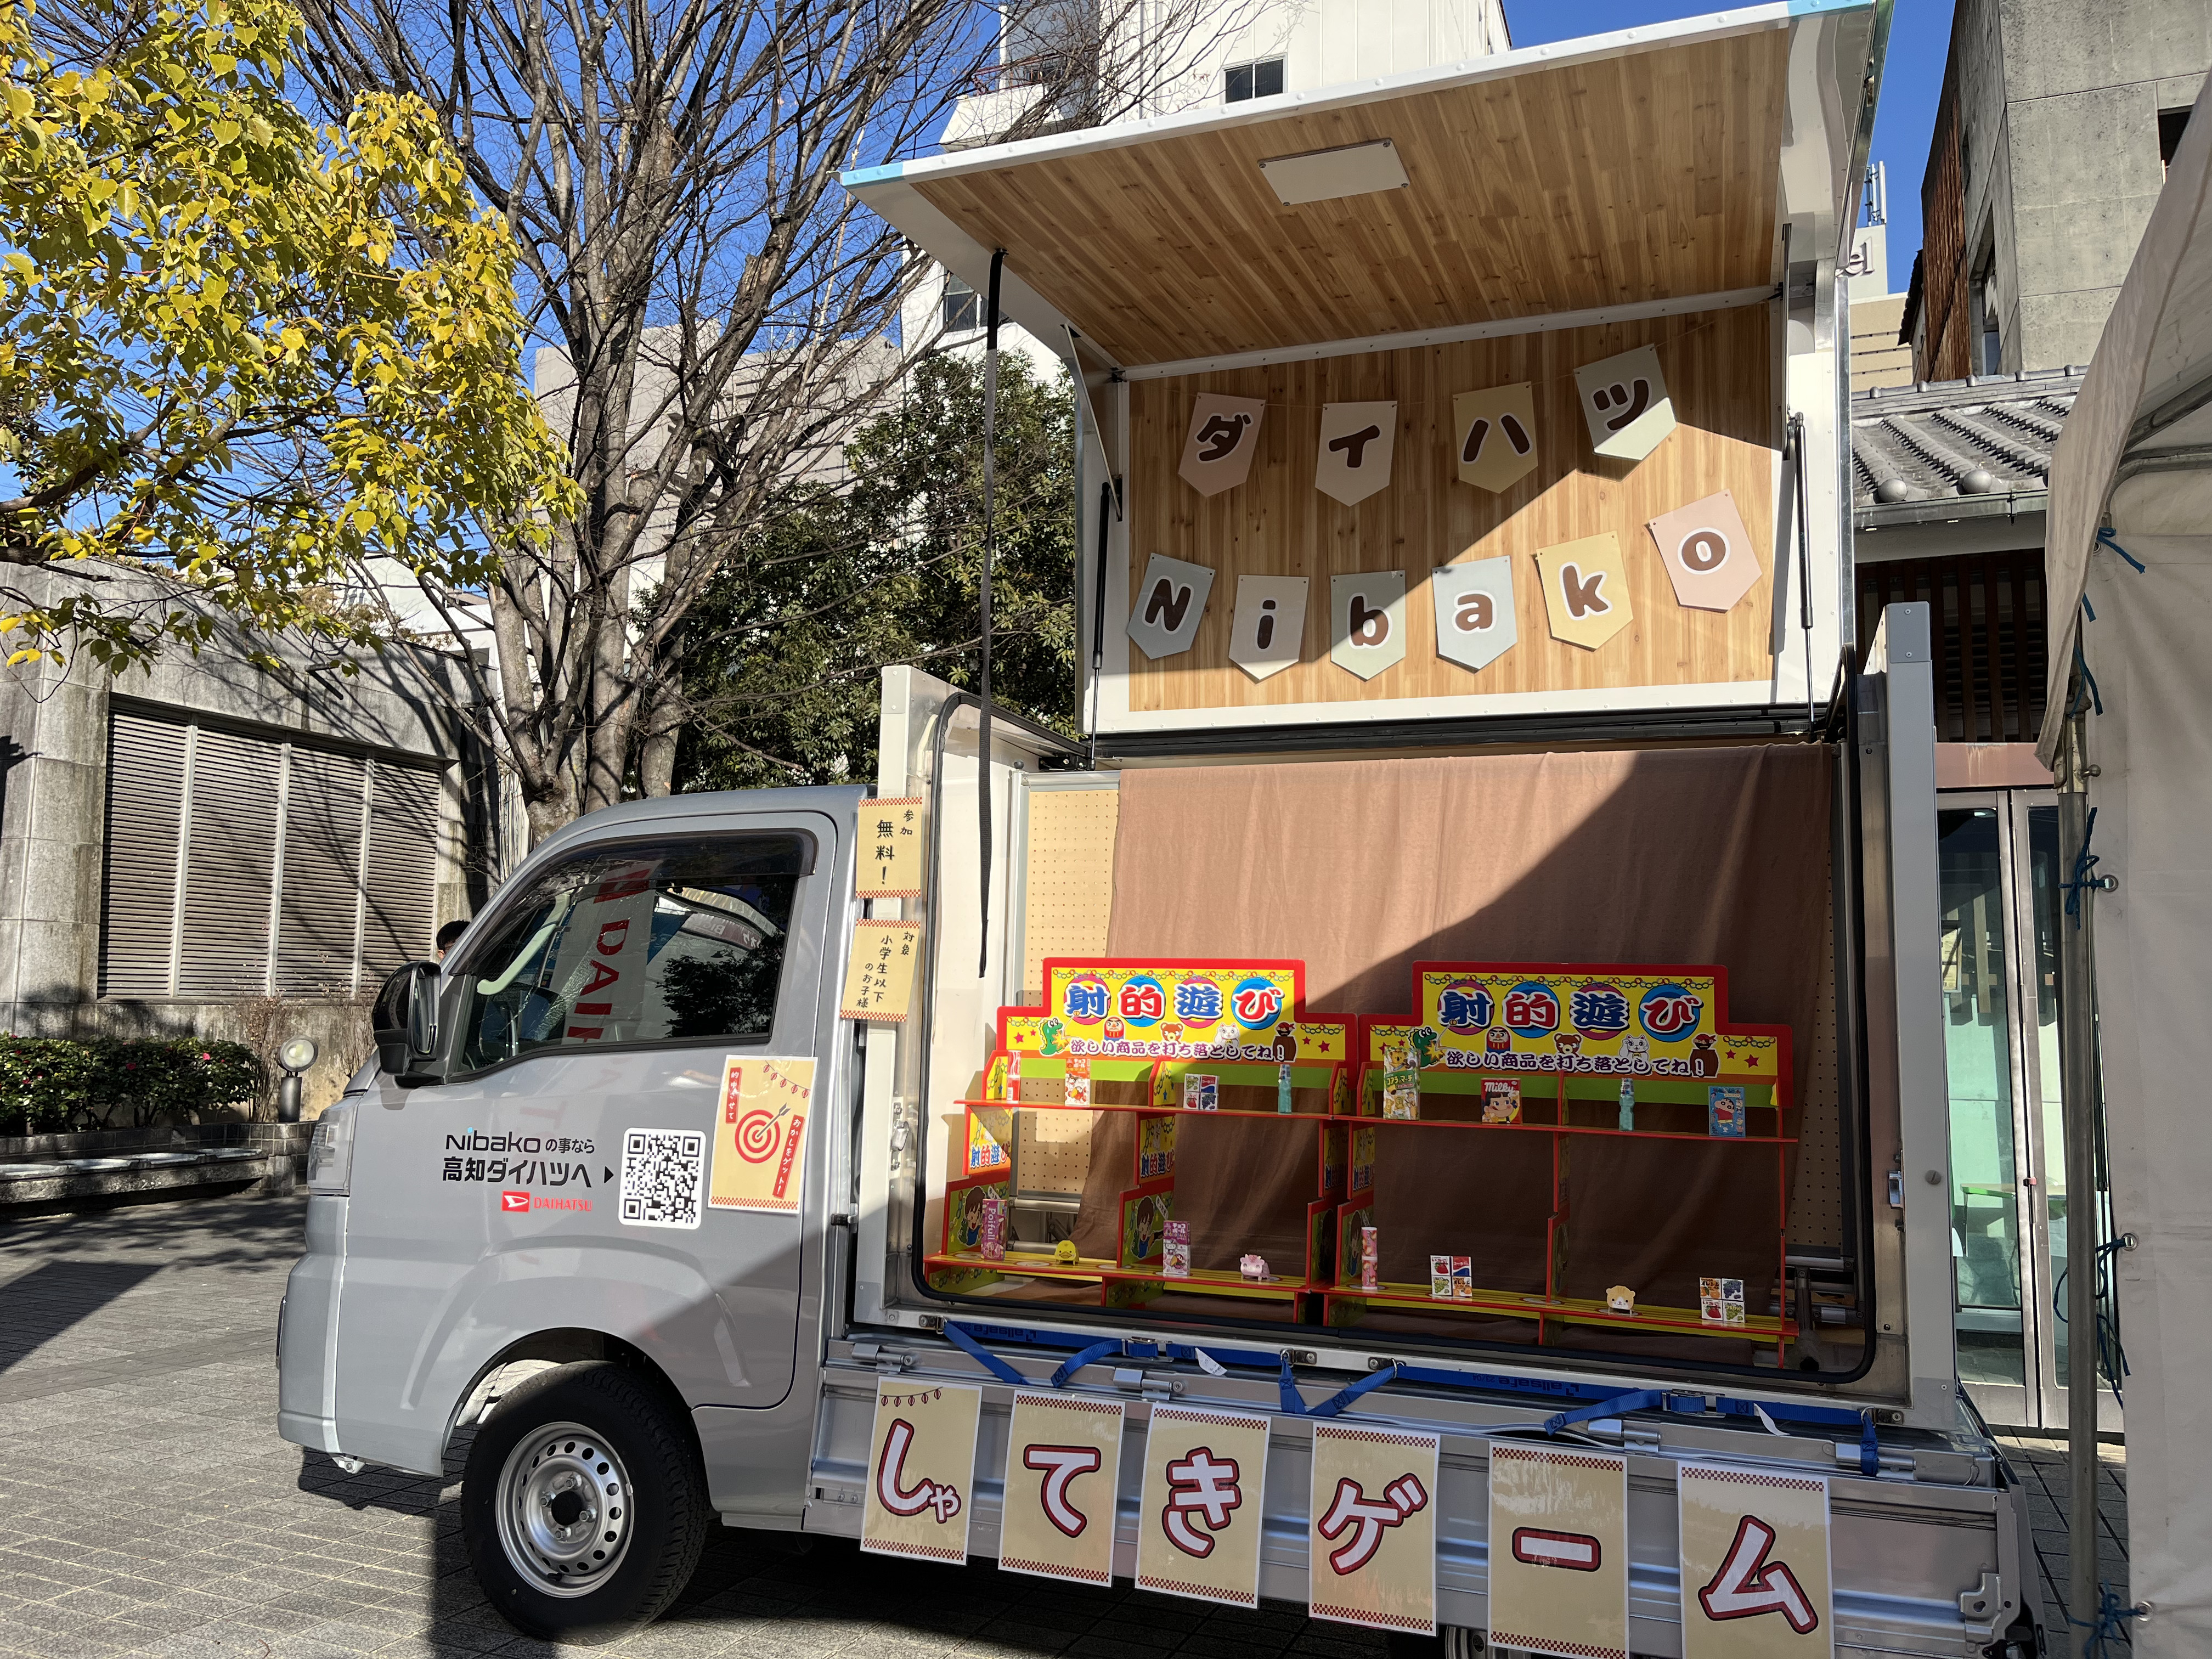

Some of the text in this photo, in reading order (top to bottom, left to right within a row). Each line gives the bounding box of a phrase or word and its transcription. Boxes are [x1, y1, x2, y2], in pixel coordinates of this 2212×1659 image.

[1194, 376, 1649, 470] ダイハツ
[1143, 527, 1731, 652] Nibako
[900, 809, 914, 836] 参加
[874, 820, 895, 884] 無料!
[900, 931, 915, 956] 対象
[856, 962, 874, 1008] のお子様
[873, 935, 893, 1002] 小学生以下
[1065, 984, 1285, 1022] 射的遊び
[1439, 991, 1703, 1032] 射的遊び
[1070, 1040, 1285, 1060] 欲しい商品を打ち落としてね!
[1447, 1052, 1704, 1076] 欲しい商品を打ち落としてね!
[445, 1127, 541, 1153] Nibako
[776, 1119, 802, 1194] おかしをゲット!
[970, 1141, 1011, 1168] 射的遊び
[443, 1156, 591, 1188] 高知ダイハツへ
[534, 1197, 593, 1212] DAIHATSU
[988, 1207, 996, 1240] Poifull
[1498, 1376, 1562, 1391] allsafe
[878, 1418, 1818, 1634] しゃてきゲーム
